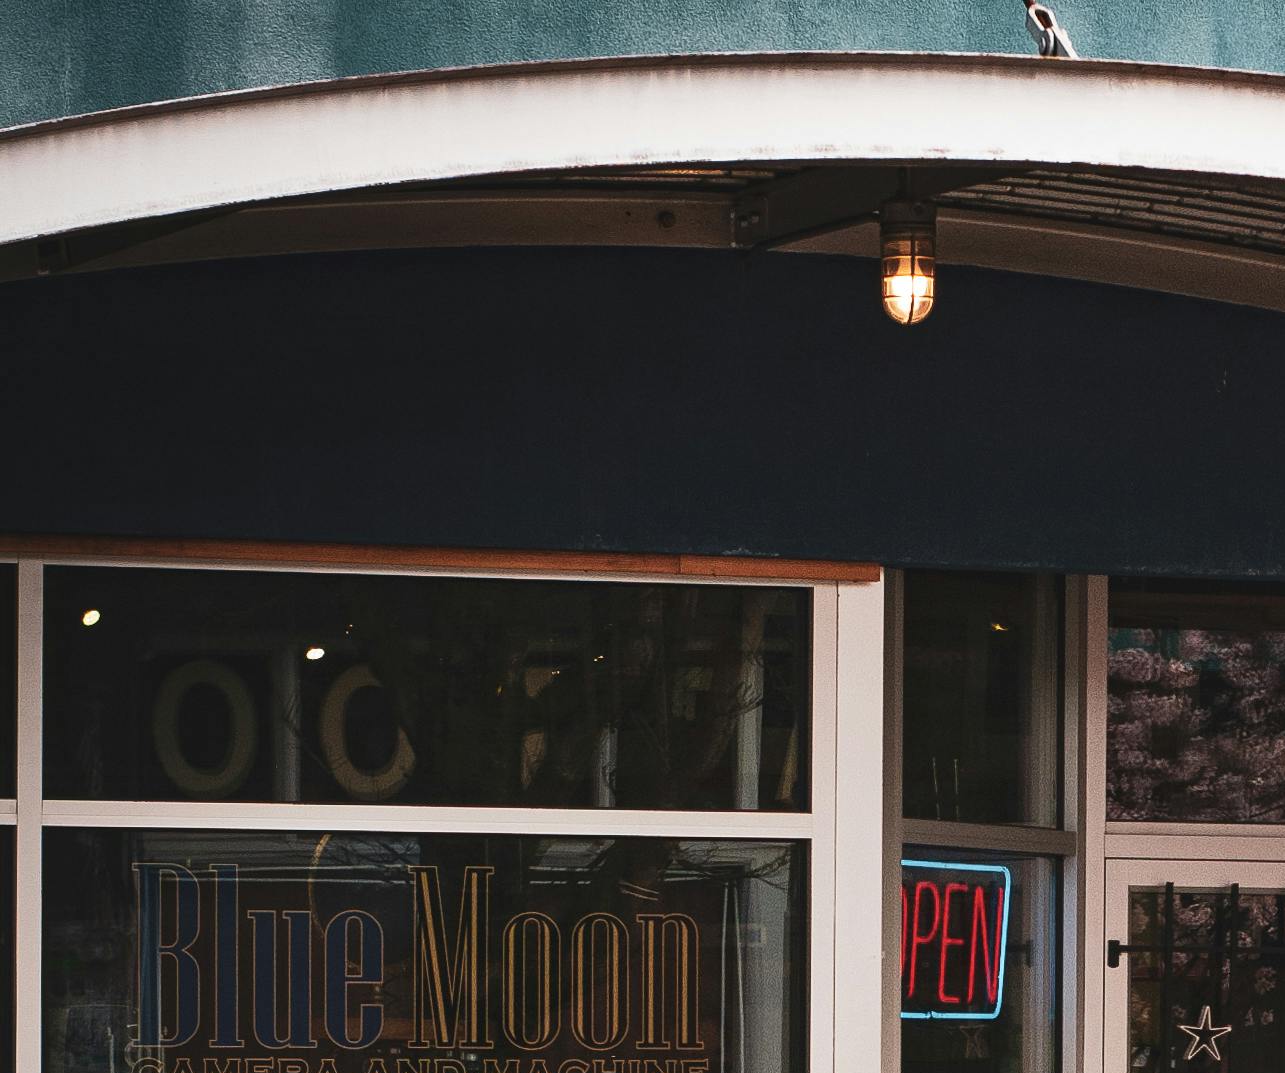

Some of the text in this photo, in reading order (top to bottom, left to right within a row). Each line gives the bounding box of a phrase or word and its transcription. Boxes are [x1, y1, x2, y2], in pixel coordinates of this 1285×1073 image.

[131, 862, 705, 1052] Blue Moon
[901, 880, 1004, 1004] PEN
